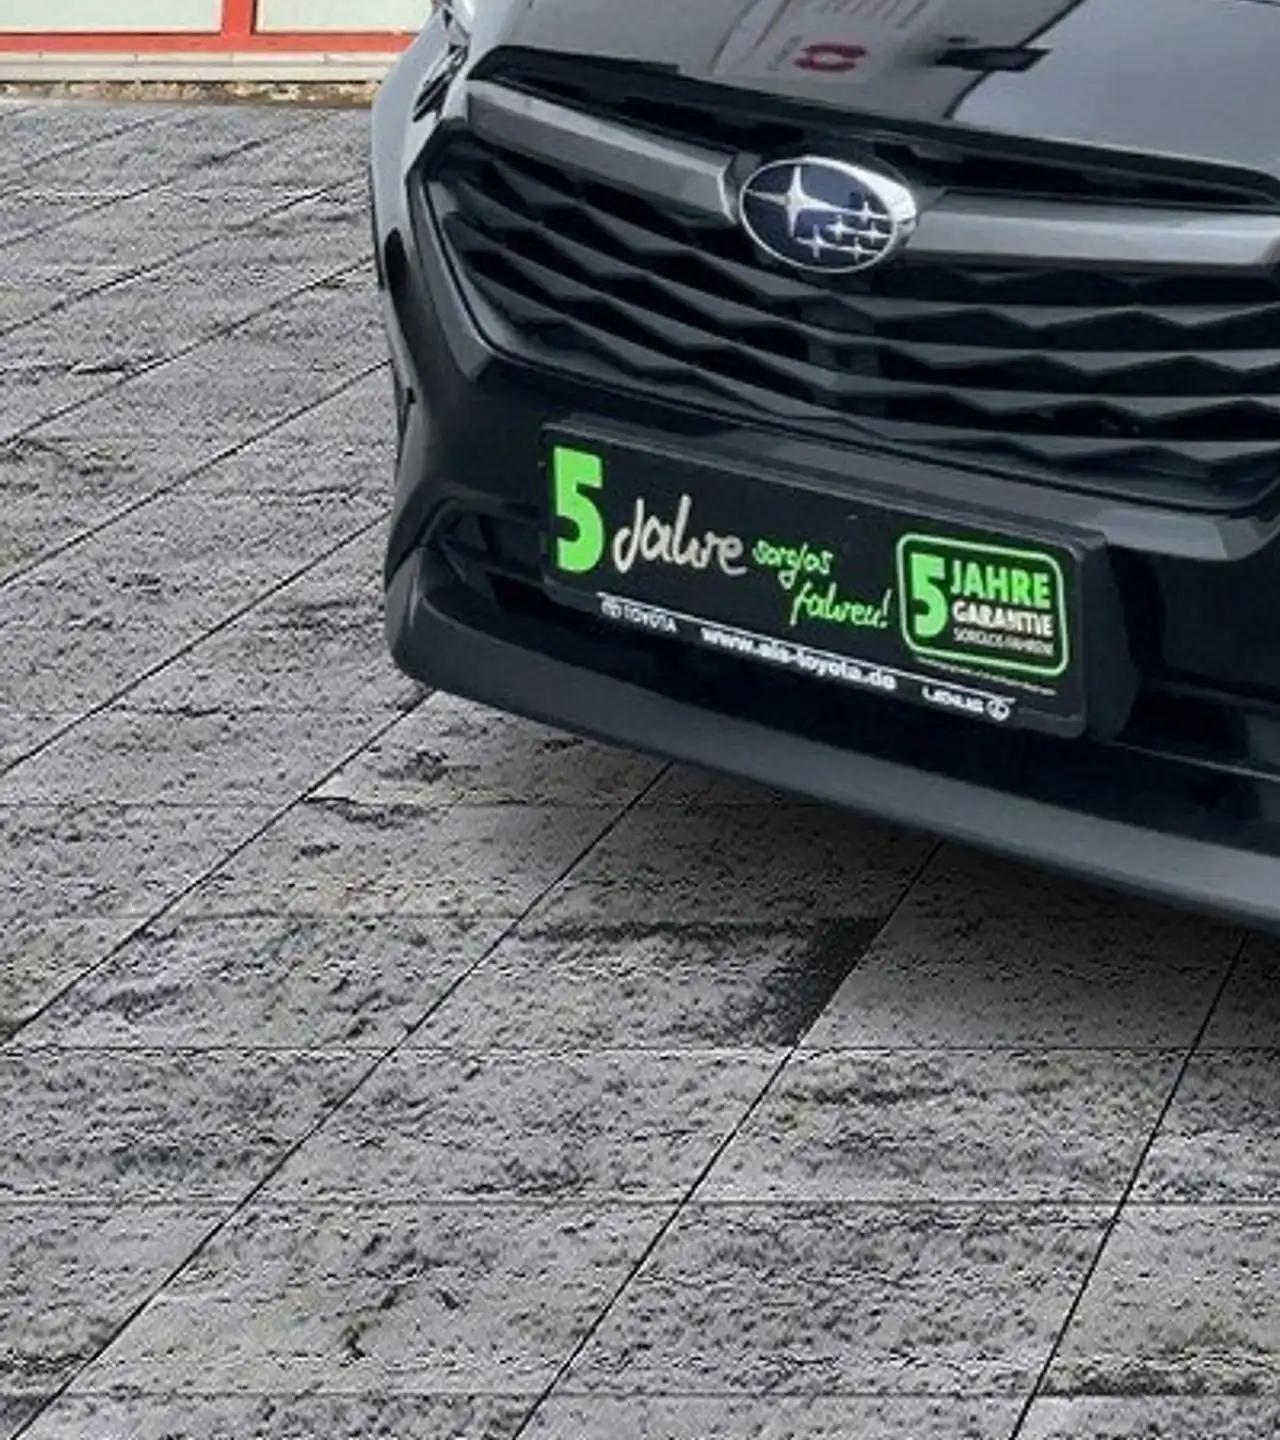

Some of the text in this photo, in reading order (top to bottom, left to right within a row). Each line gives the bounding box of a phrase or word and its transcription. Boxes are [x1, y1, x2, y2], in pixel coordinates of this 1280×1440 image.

[554, 446, 834, 590] 5 Jahre sorglos
[625, 603, 678, 633] TOYOTA
[789, 581, 893, 629] fahren!
[910, 552, 1051, 638] 5 JAHRE
[952, 599, 1053, 637] GARANTIE
